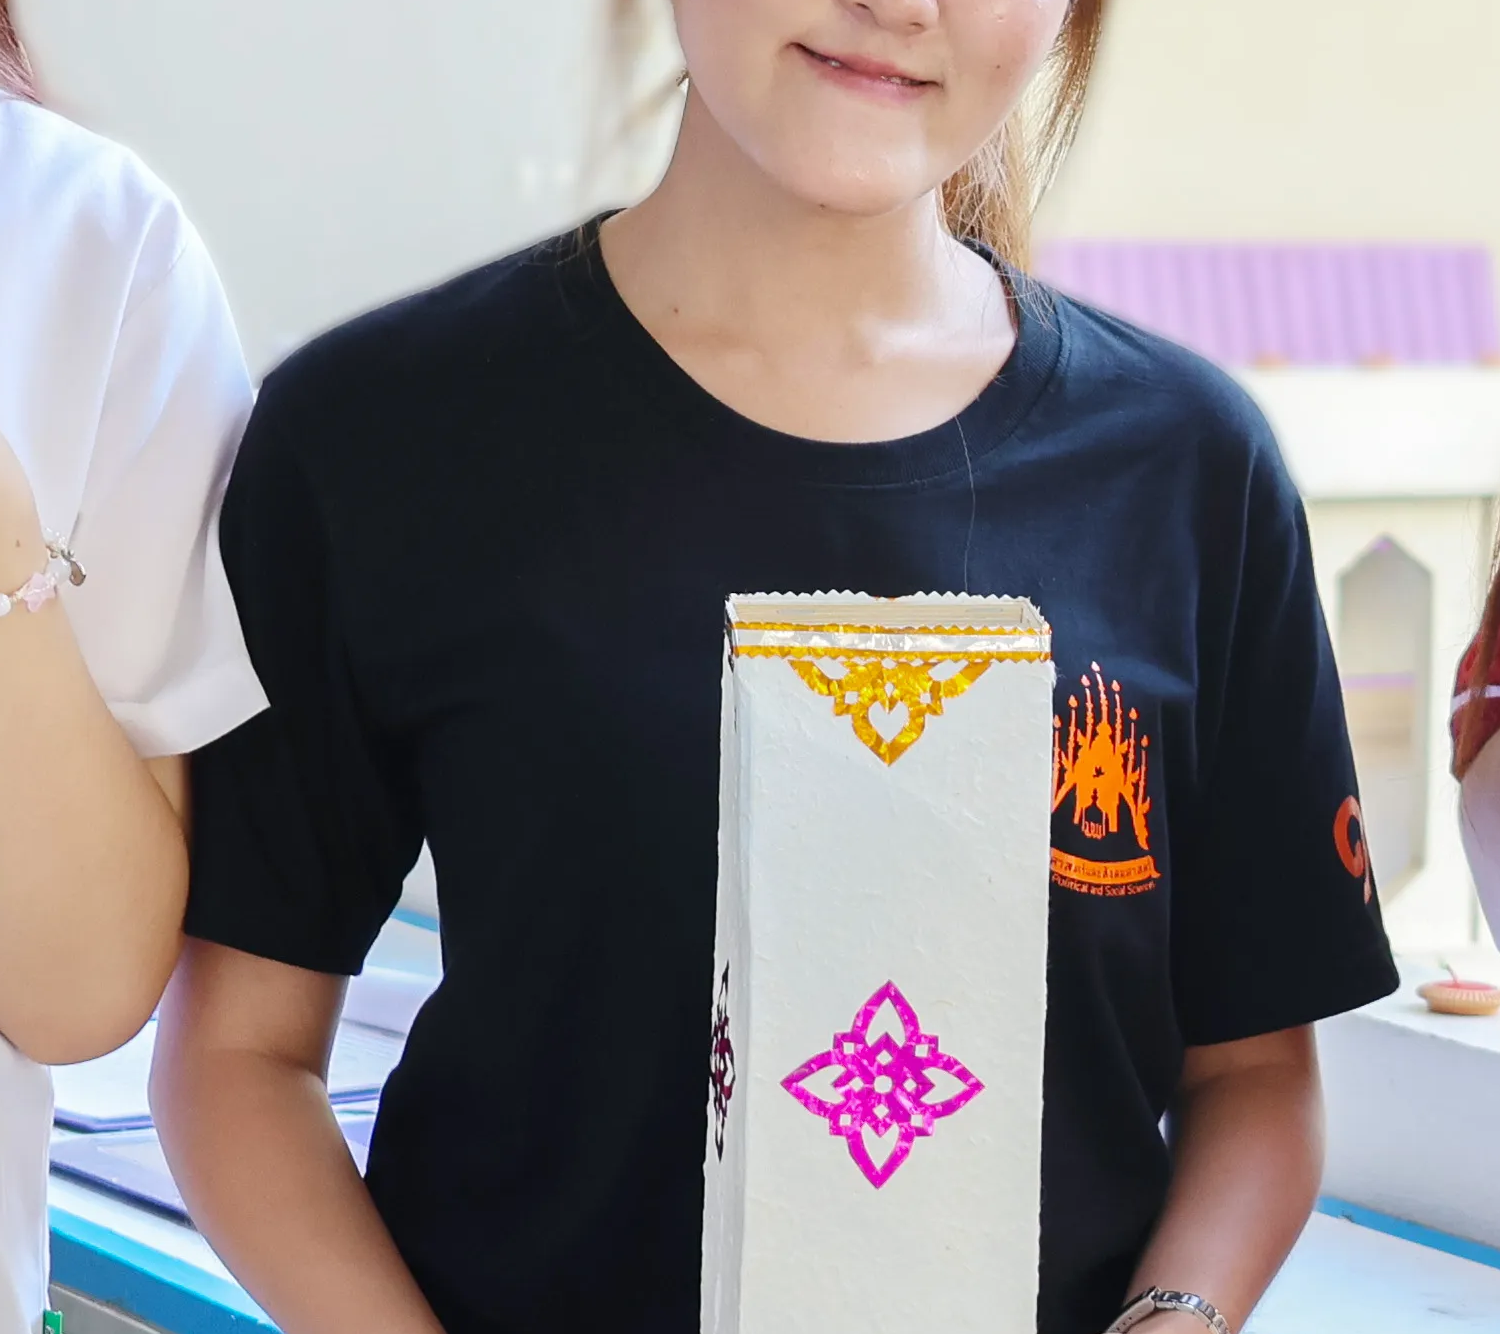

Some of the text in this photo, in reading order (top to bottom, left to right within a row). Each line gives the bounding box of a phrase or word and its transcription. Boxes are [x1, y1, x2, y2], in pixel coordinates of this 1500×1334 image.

[1052, 873, 1089, 894] Political
[1090, 883, 1104, 896] and
[1105, 885, 1126, 897] Social
